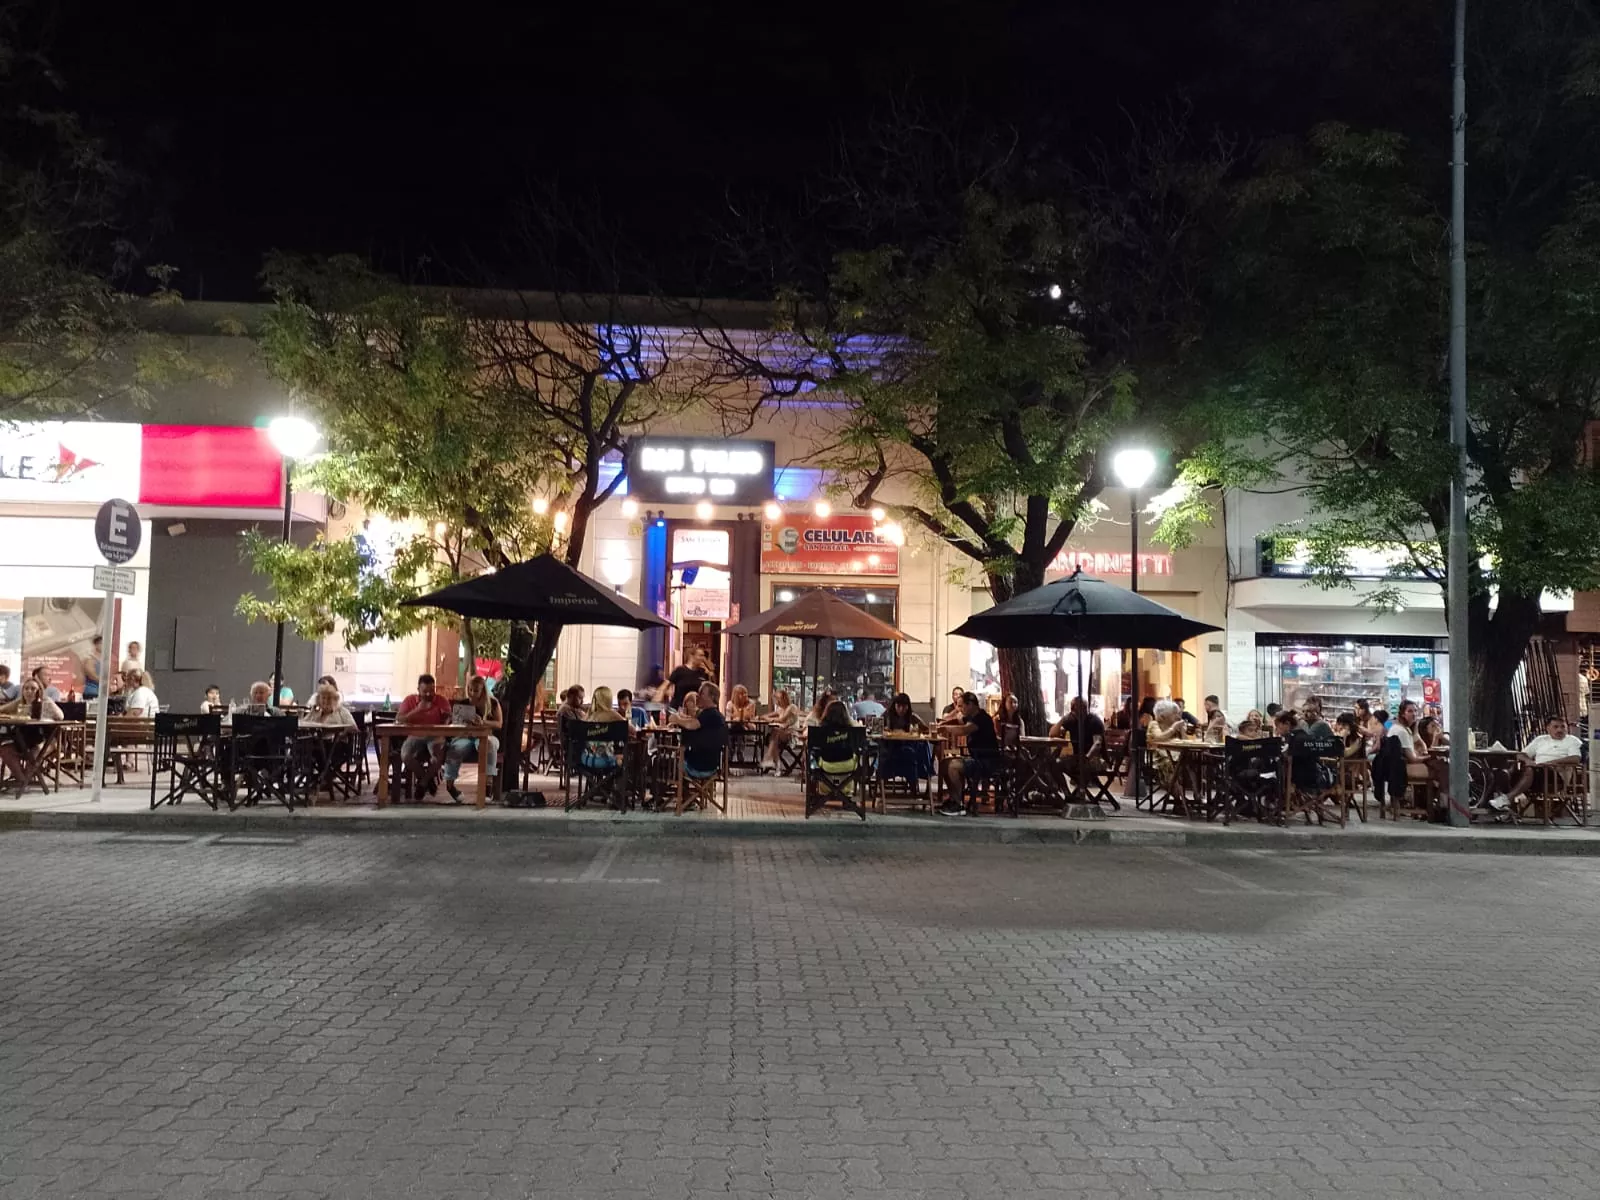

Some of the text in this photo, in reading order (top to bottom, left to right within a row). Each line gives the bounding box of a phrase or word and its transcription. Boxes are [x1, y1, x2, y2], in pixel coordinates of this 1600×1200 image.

[109, 505, 129, 545] E
[803, 528, 894, 545] CELULARE
[548, 594, 599, 607] Imperial
